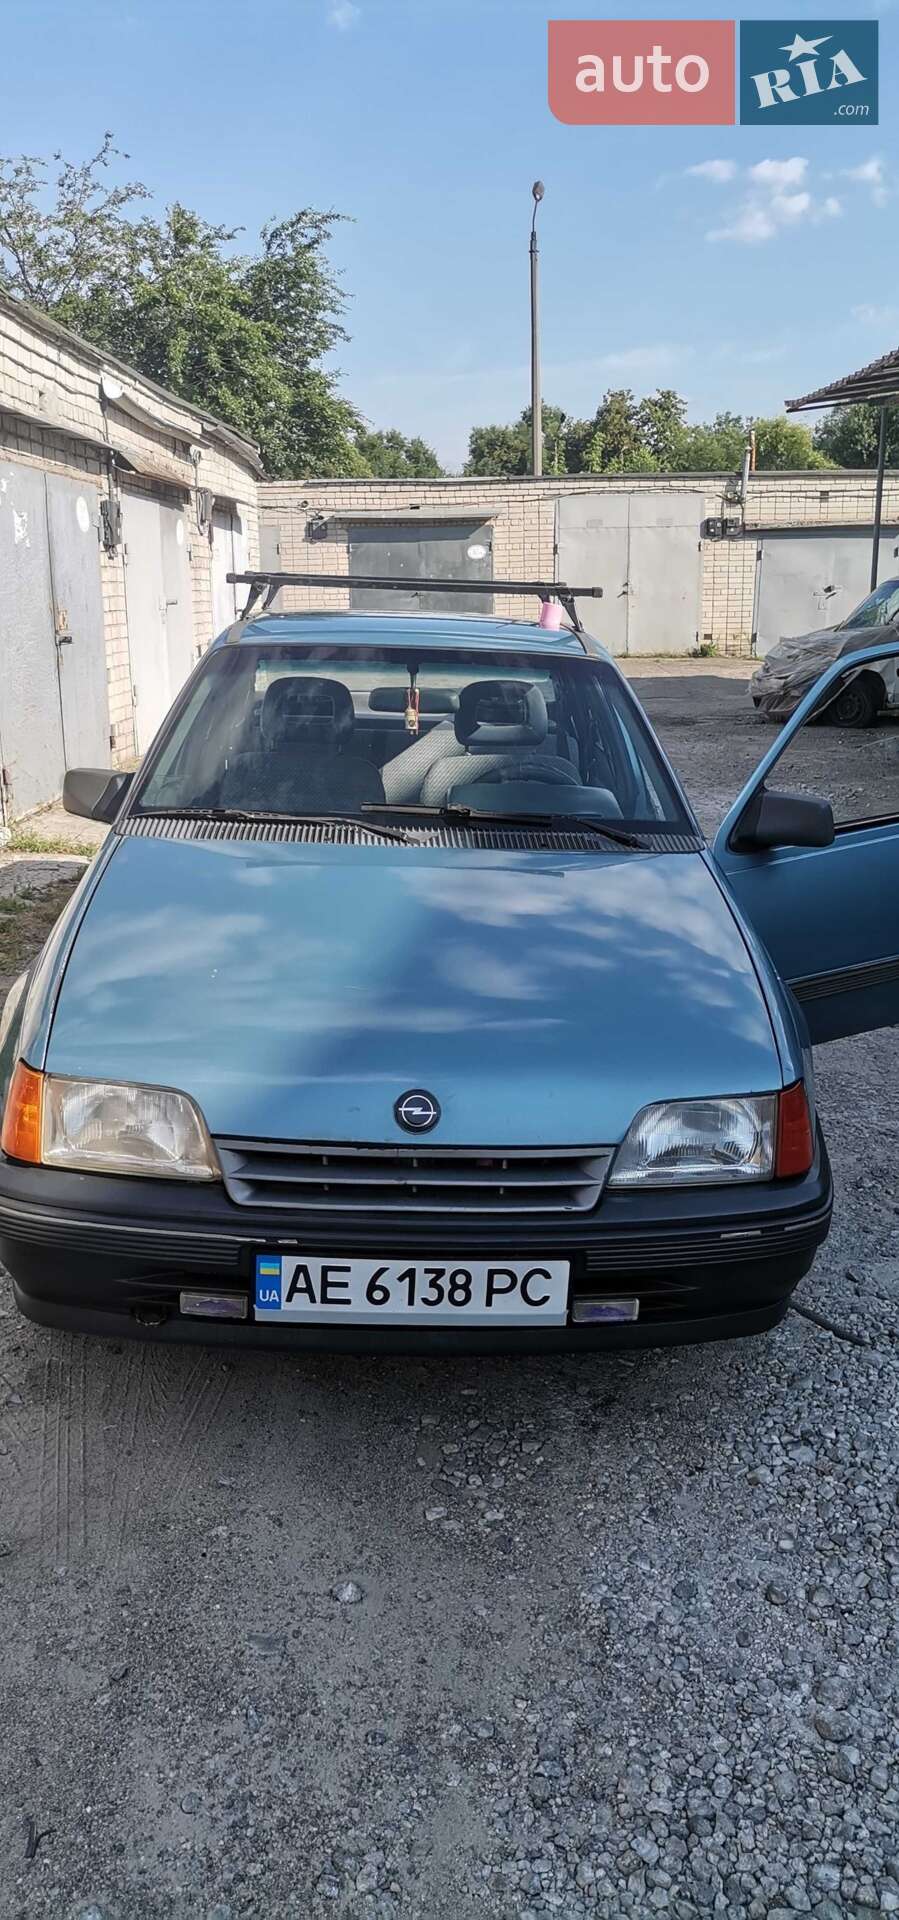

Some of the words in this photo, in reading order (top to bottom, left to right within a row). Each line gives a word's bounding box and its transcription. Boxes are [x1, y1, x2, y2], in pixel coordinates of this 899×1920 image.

[259, 1289, 279, 1302] UA
[285, 1264, 351, 1305] AE
[365, 1266, 472, 1307] 6138
[485, 1267, 552, 1307] PC
